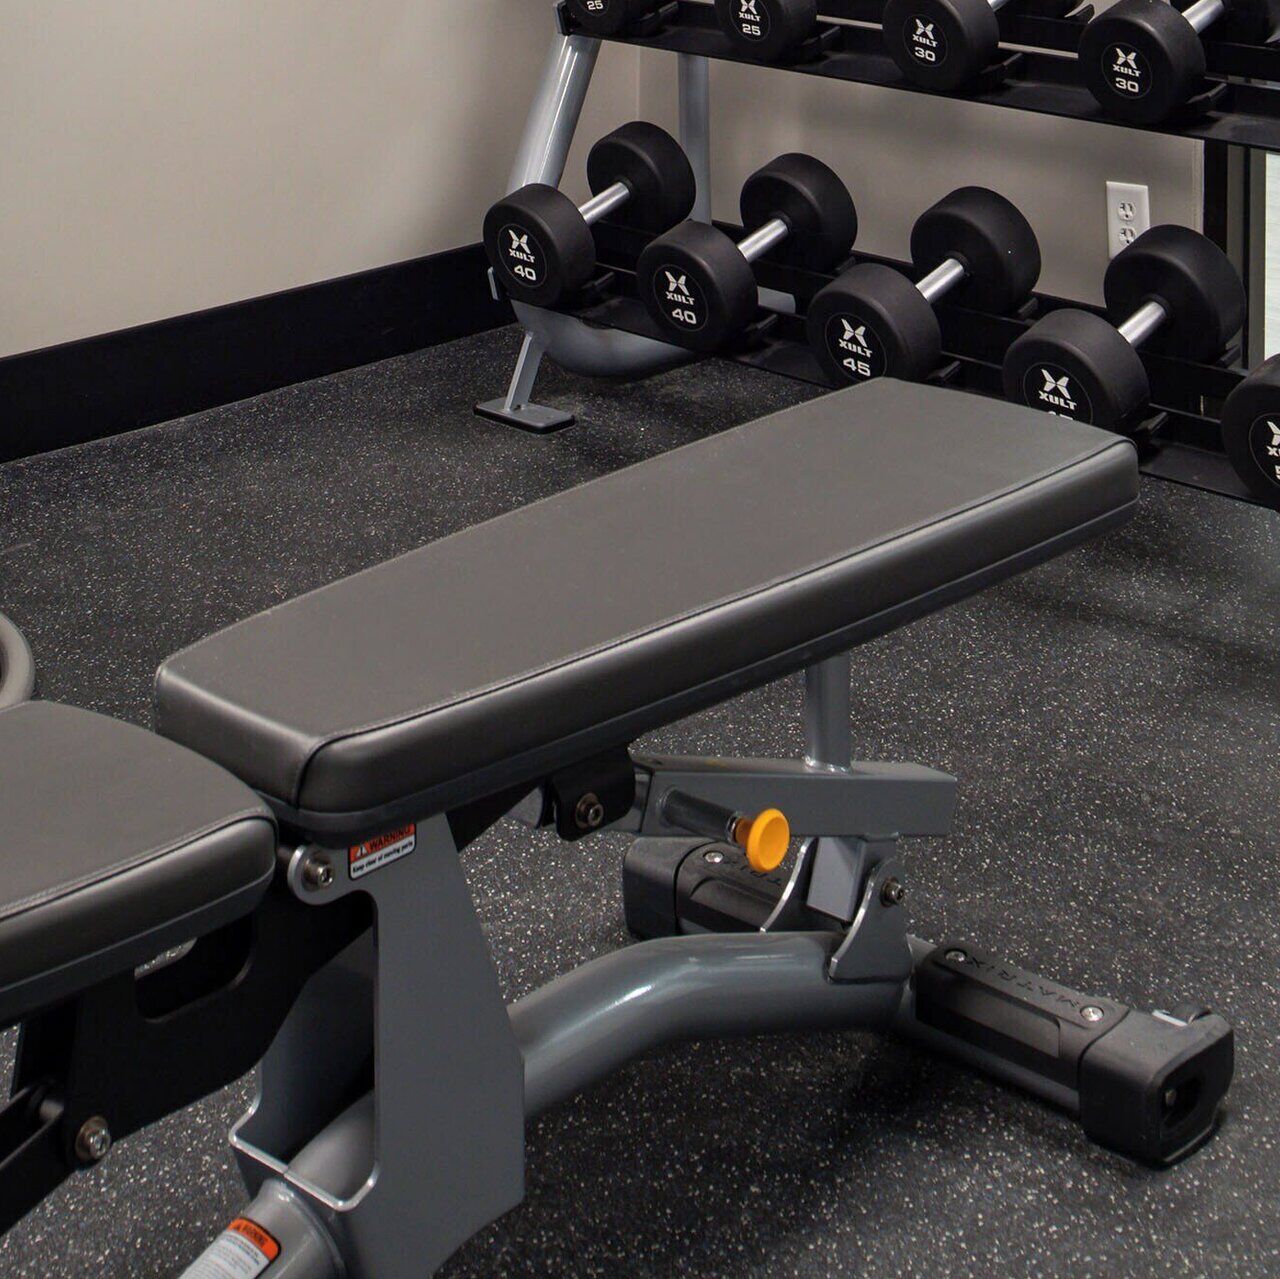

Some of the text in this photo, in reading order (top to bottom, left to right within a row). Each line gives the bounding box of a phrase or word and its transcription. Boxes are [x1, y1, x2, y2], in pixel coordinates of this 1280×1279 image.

[587, 0, 603, 10] 25
[739, 12, 760, 21] XULT
[742, 23, 761, 36] 25
[913, 34, 937, 47] XULT
[915, 47, 935, 61] 30
[1113, 64, 1141, 77] XULT
[1116, 77, 1139, 92] 30
[509, 249, 535, 263] XULT
[514, 265, 536, 280] 40
[666, 291, 694, 305] XULT
[672, 308, 696, 324] 40
[839, 339, 872, 357] XULT
[843, 358, 870, 376] 45
[1039, 391, 1077, 410] XULT
